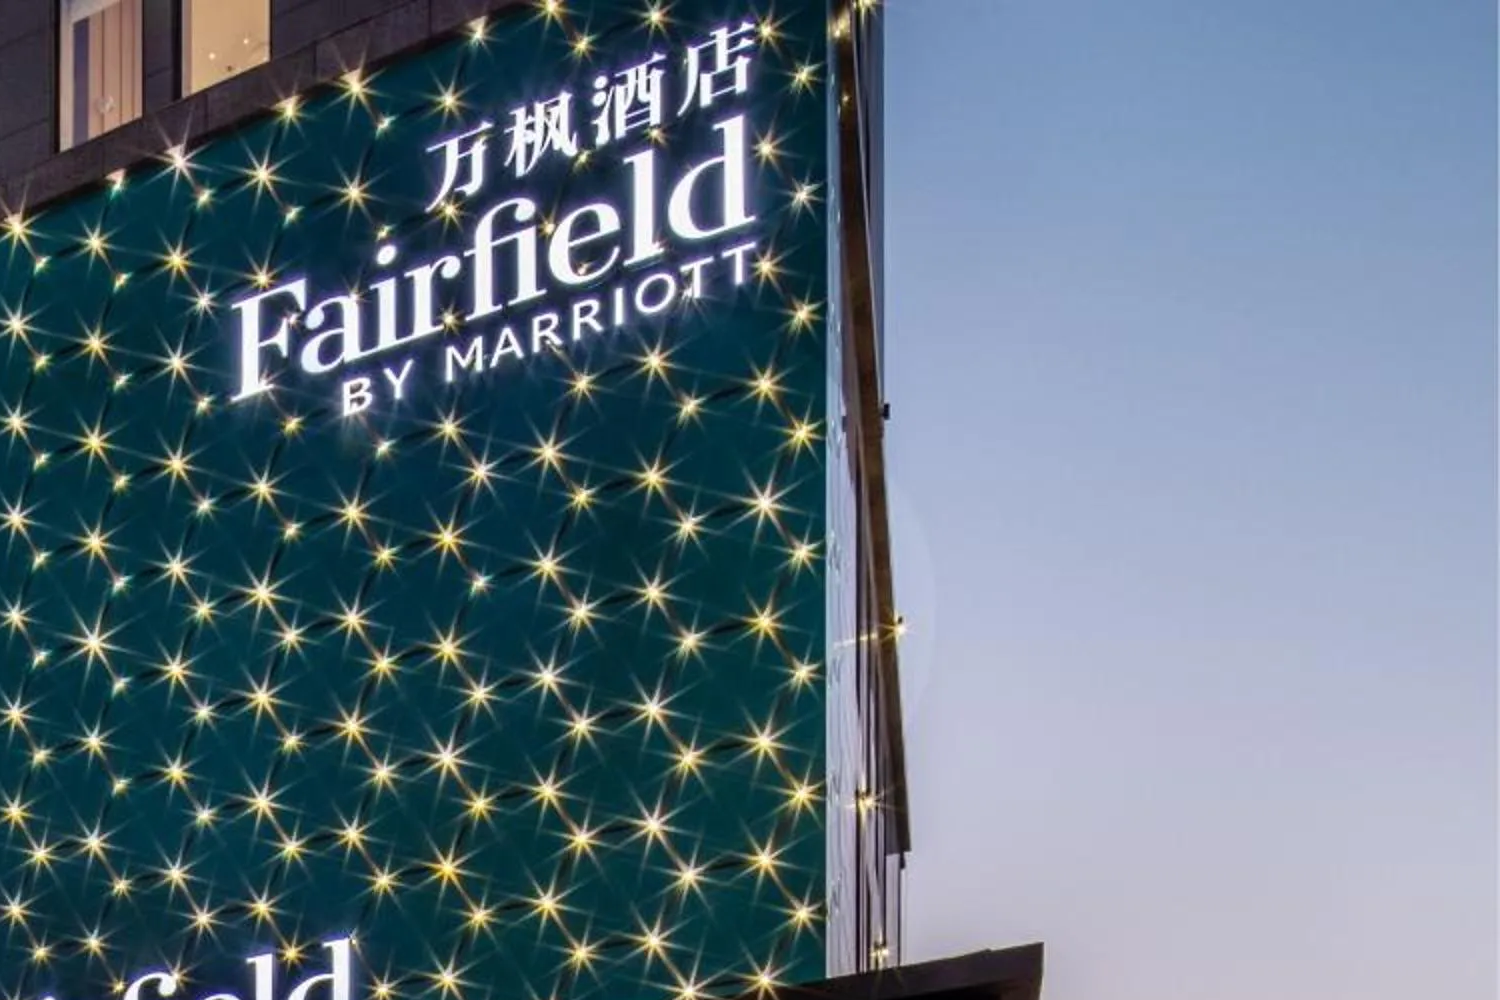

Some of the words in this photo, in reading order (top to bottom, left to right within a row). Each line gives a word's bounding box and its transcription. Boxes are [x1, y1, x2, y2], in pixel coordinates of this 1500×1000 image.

[426, 22, 756, 212] 万枫酒店
[231, 115, 755, 401] Fairfield
[343, 360, 413, 416] BY
[445, 243, 756, 382] MARRIOTT
